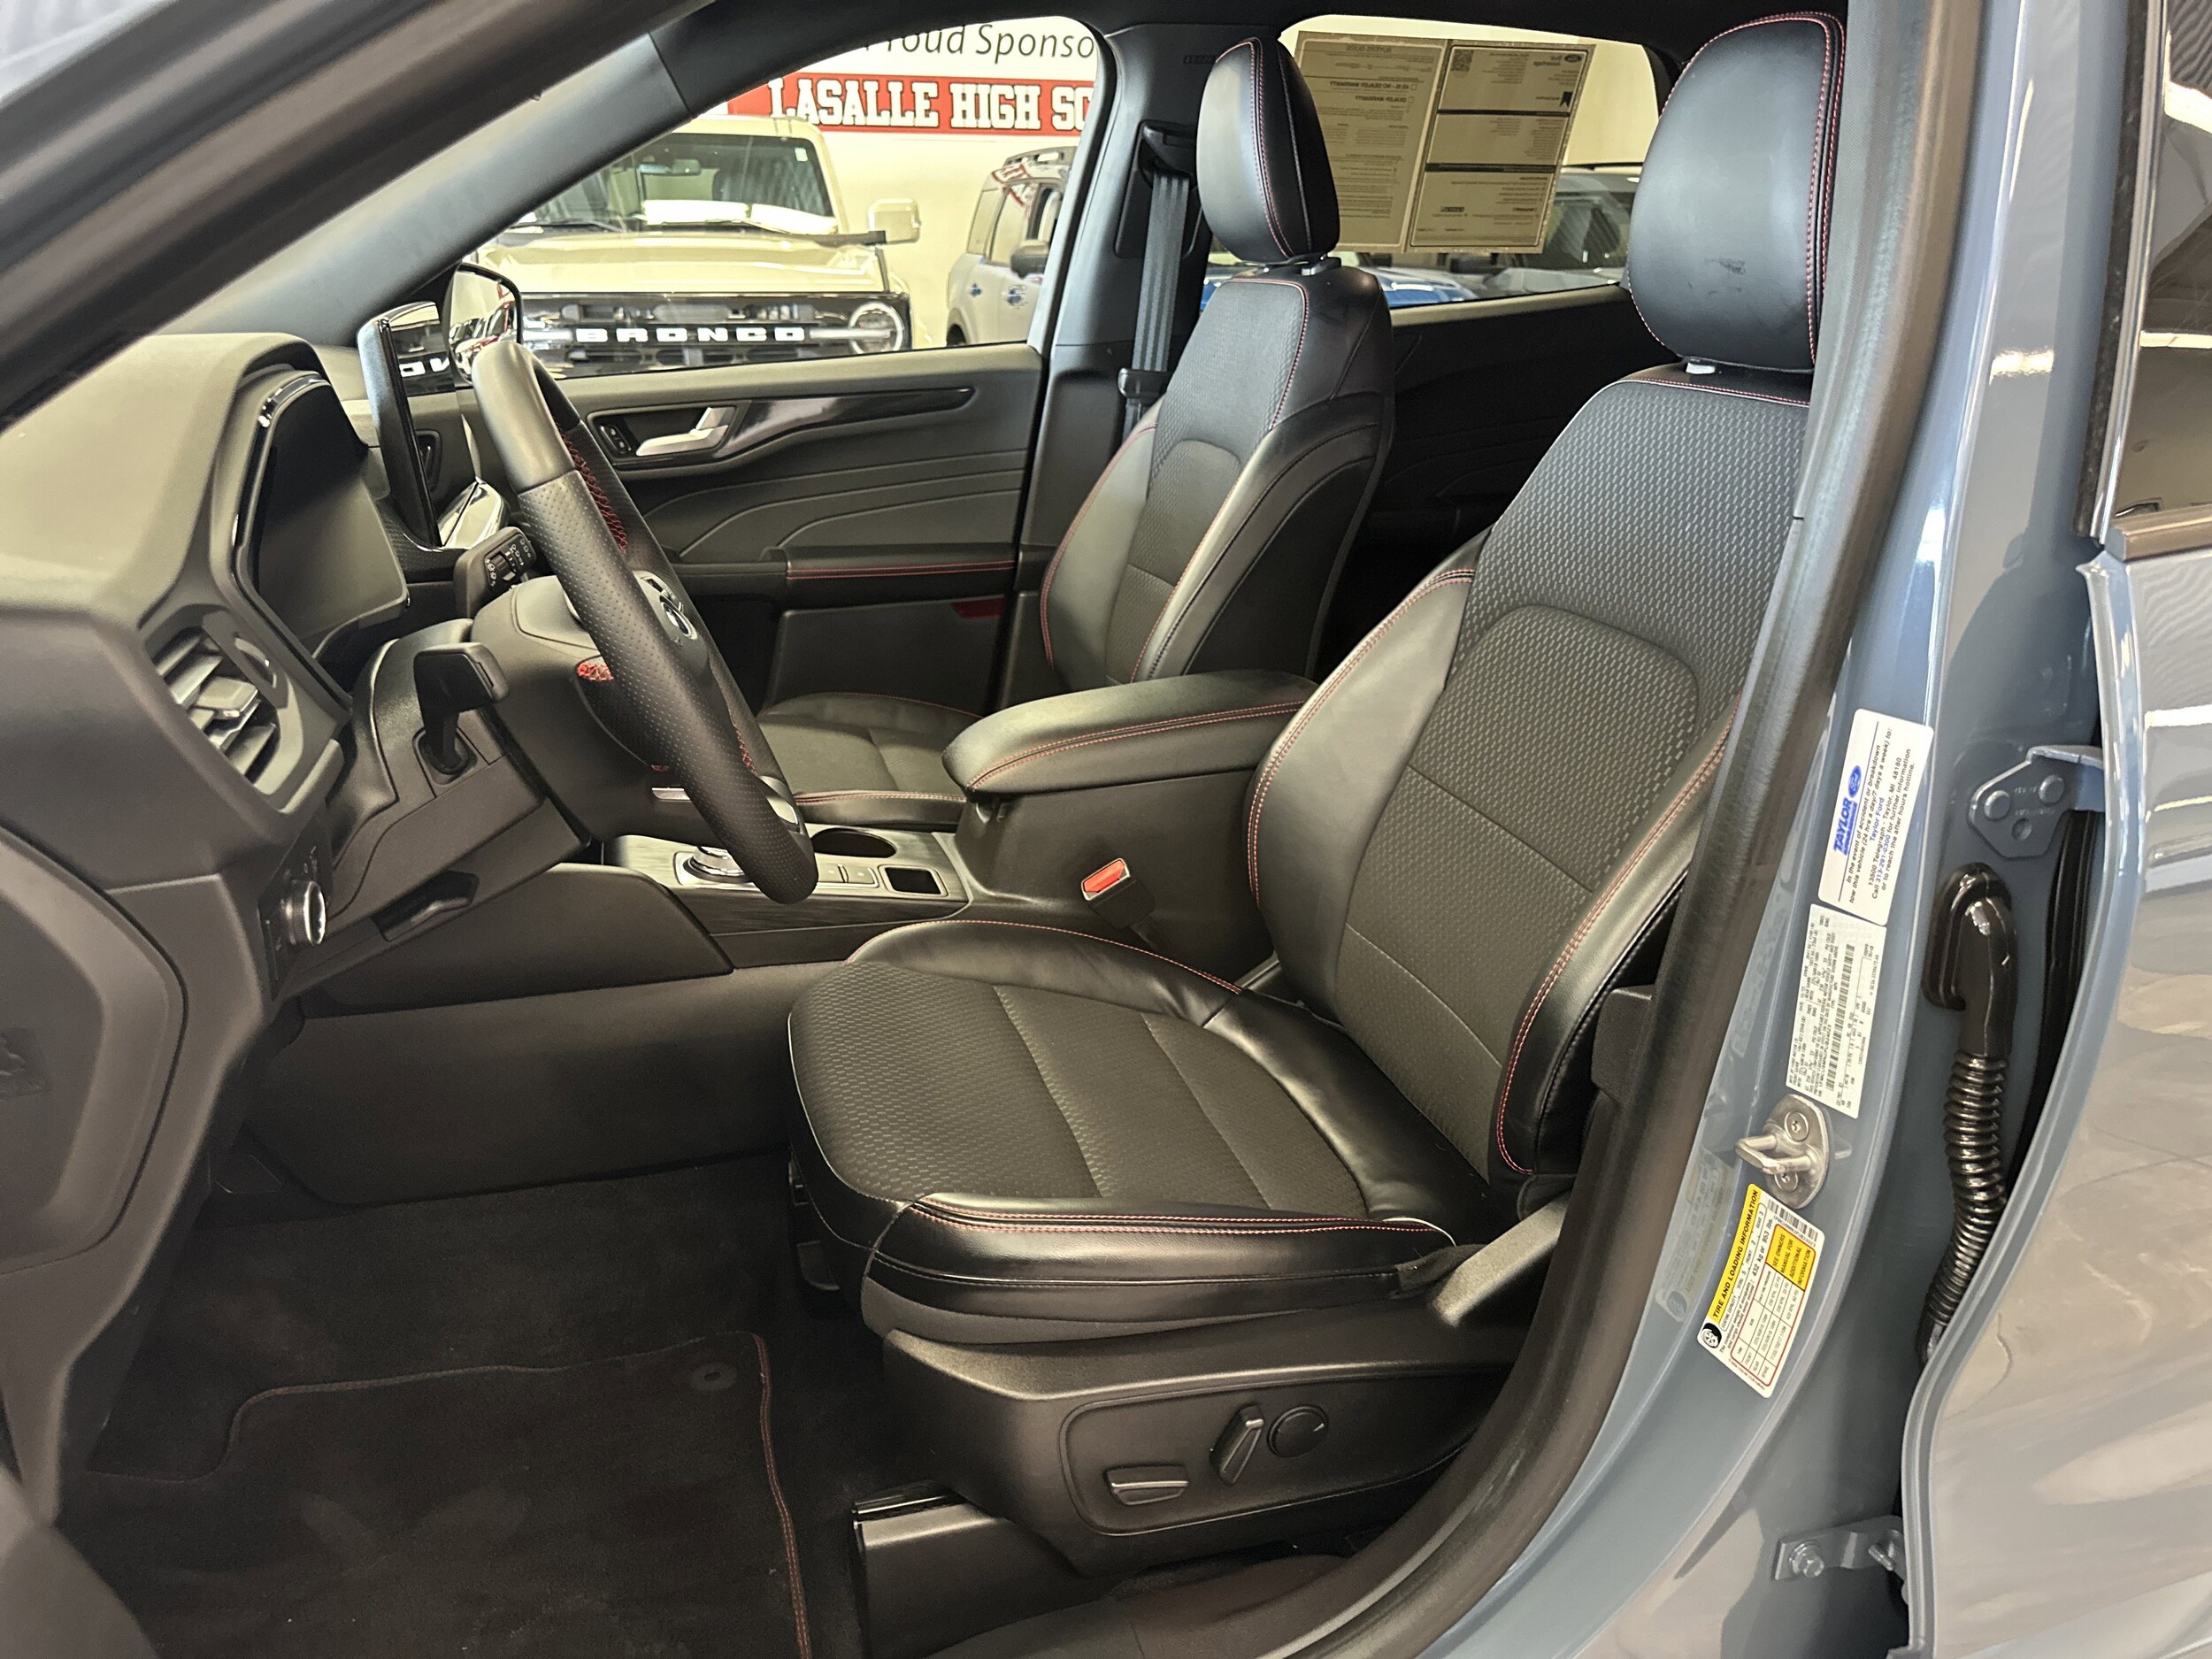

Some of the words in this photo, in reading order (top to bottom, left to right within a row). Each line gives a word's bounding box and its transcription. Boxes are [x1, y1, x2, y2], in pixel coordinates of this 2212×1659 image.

[768, 78, 940, 128] LASALLE
[949, 83, 1041, 130] HIGH
[576, 328, 805, 342] BRONCO
[1866, 744, 1880, 787] breakdown
[1902, 761, 1915, 791] hotline.
[1855, 846, 1865, 872] vehicle
[1868, 790, 1878, 811] day/7
[1873, 771, 1883, 789] days
[1879, 740, 1890, 763] week)
[1857, 797, 1869, 829] accident
[1875, 833, 1891, 882] 313-291-0300
[1889, 794, 1900, 820] further
[1895, 748, 1910, 793] information
[1897, 792, 1907, 815] hours
[1832, 797, 1852, 852] TAYLOR
[1867, 864, 1877, 886] 13500
[1872, 826, 1886, 863] Telegraph
[1892, 757, 1901, 780] 48180
[1870, 818, 1880, 842] Taylor
[1875, 796, 1884, 816] Ford
[1893, 817, 1901, 834] after
[1855, 830, 1862, 839] of
[1850, 839, 1859, 860] event
[1885, 849, 1893, 871] reach
[1880, 881, 1886, 890] or
[1882, 872, 1888, 880] to
[1761, 1230, 1770, 1243] 953
[1775, 1233, 1785, 1256] OWNERS
[1712, 1298, 1724, 1318] TIRE
[1720, 1281, 1730, 1299] AND
[1727, 1245, 1742, 1280] LOADING
[1740, 1189, 1757, 1244] INFORMATION
[1756, 1253, 1763, 1263] kg
[1759, 1245, 1765, 1254] or
[1779, 1250, 1790, 1273] MANUAL
[1789, 1245, 1801, 1278] ADDITIONAL
[1797, 1248, 1810, 1286] INFORMATION
